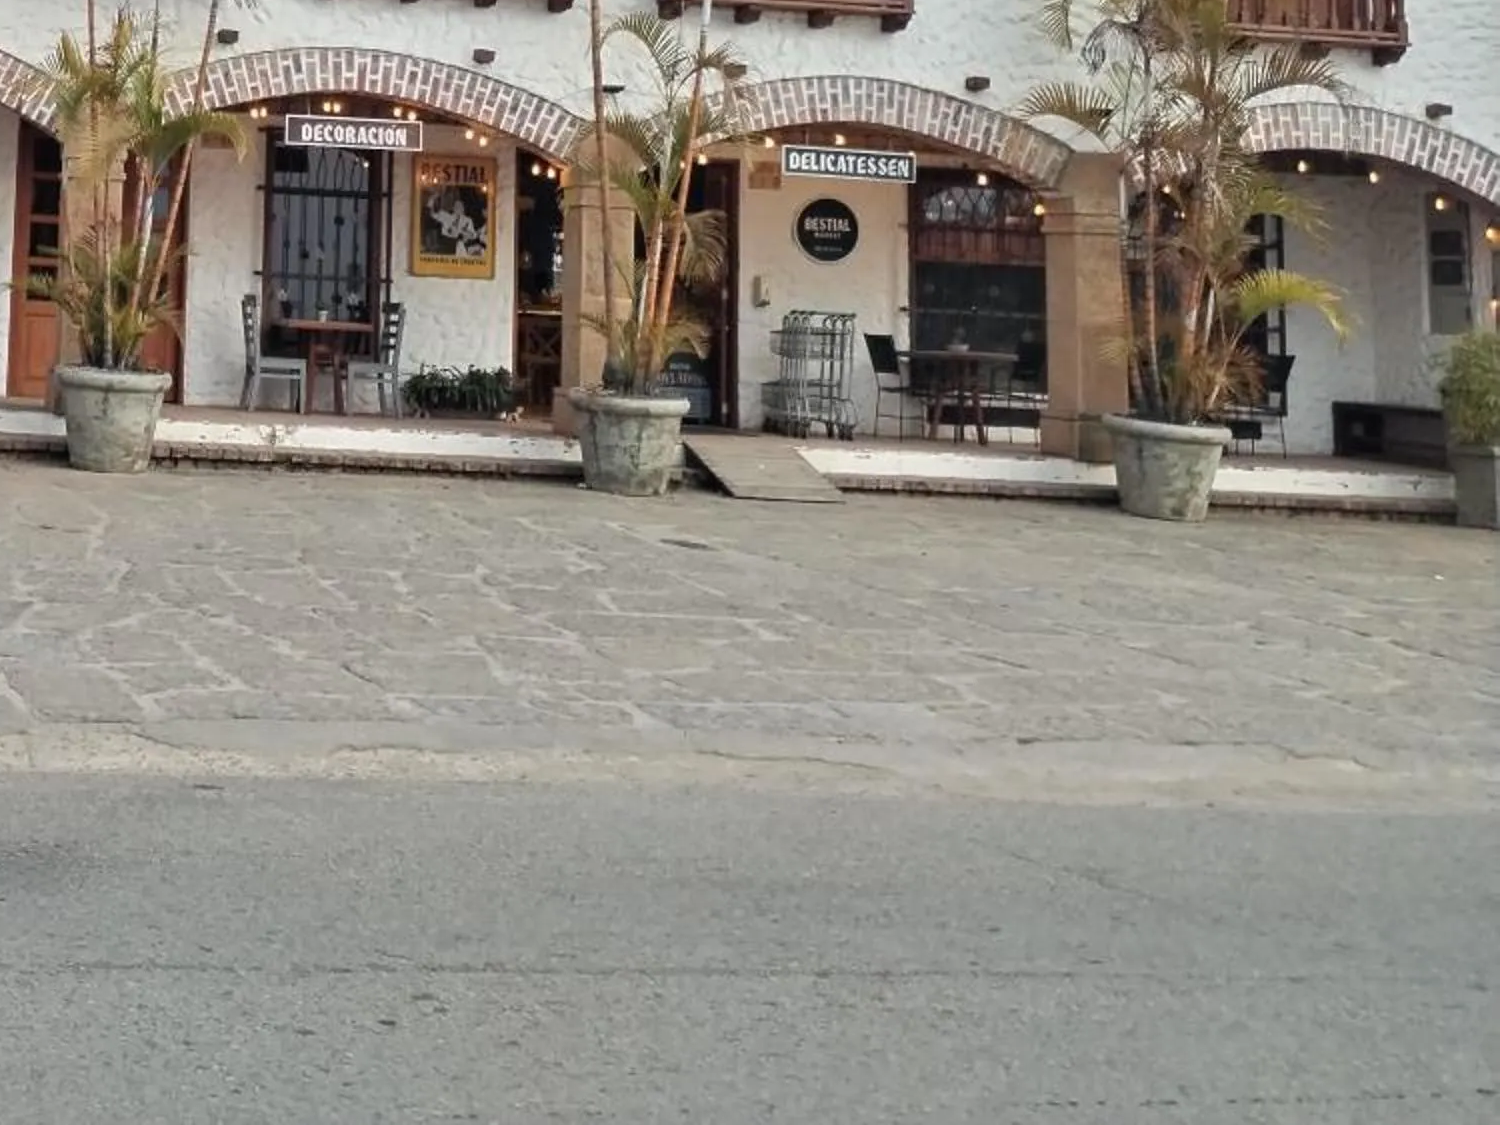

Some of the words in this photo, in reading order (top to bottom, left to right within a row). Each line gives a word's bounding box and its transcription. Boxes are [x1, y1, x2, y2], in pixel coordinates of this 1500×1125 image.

[301, 123, 407, 146] DECORACIÓN
[421, 161, 488, 184] BESTIAL
[788, 152, 910, 177] DELICATESSEN
[804, 217, 851, 232] BESTIAL
